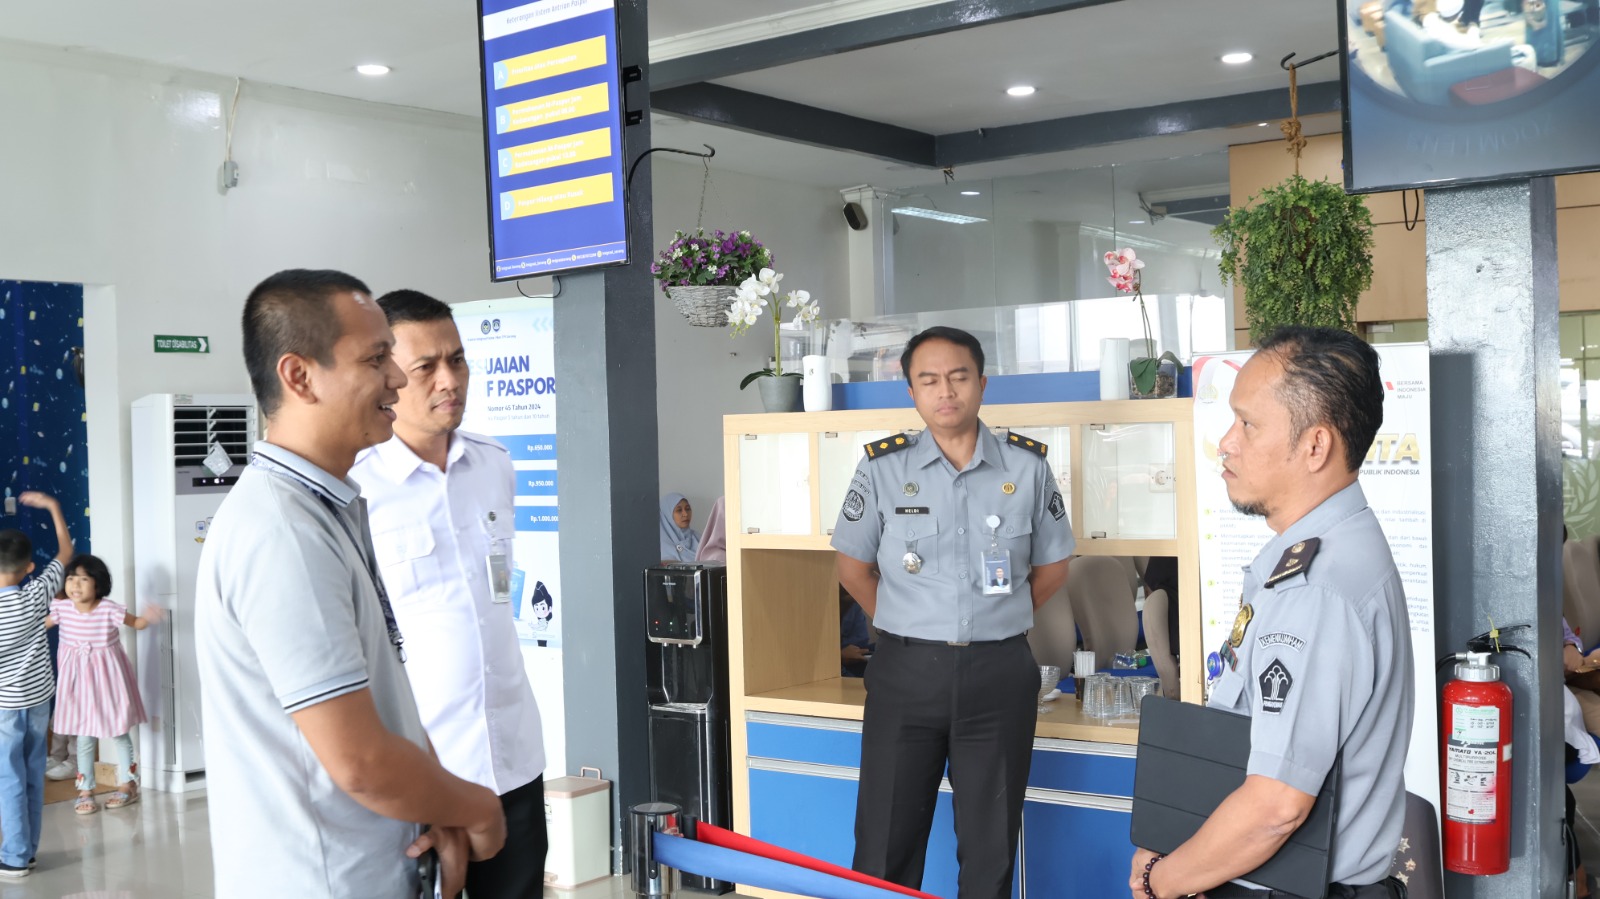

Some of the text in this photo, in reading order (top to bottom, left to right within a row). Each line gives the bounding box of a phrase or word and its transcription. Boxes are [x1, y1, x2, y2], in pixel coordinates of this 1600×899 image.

[497, 70, 505, 80] A
[499, 115, 506, 125] B
[502, 157, 509, 167] C
[504, 201, 511, 211] D
[156, 339, 198, 349] TOILET DISABILITAS
[497, 377, 556, 397] PASPOR
